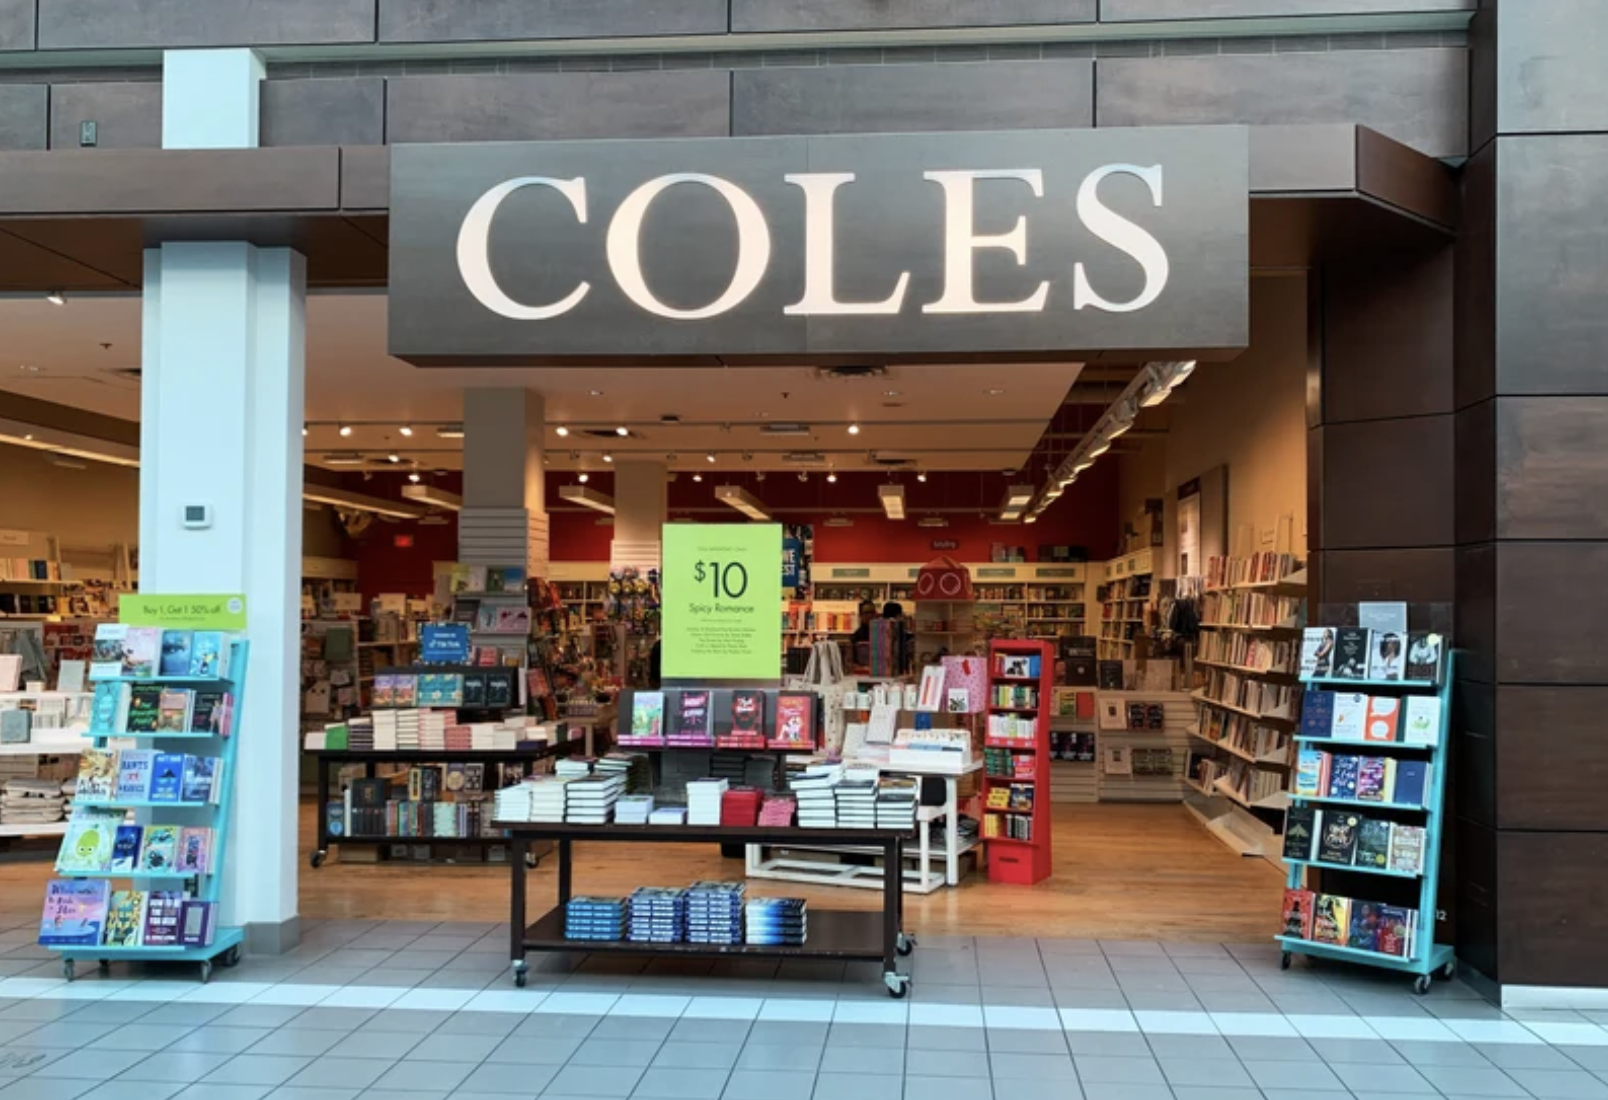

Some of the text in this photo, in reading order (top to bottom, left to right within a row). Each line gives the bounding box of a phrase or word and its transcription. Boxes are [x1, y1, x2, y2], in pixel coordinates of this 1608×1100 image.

[455, 163, 1169, 321] COLES
[694, 560, 748, 599] $10
[143, 605, 158, 616] Buy
[166, 605, 182, 614] Get
[191, 605, 209, 614] 50%
[210, 605, 221, 614] off
[689, 603, 754, 615] Spicy Romance
